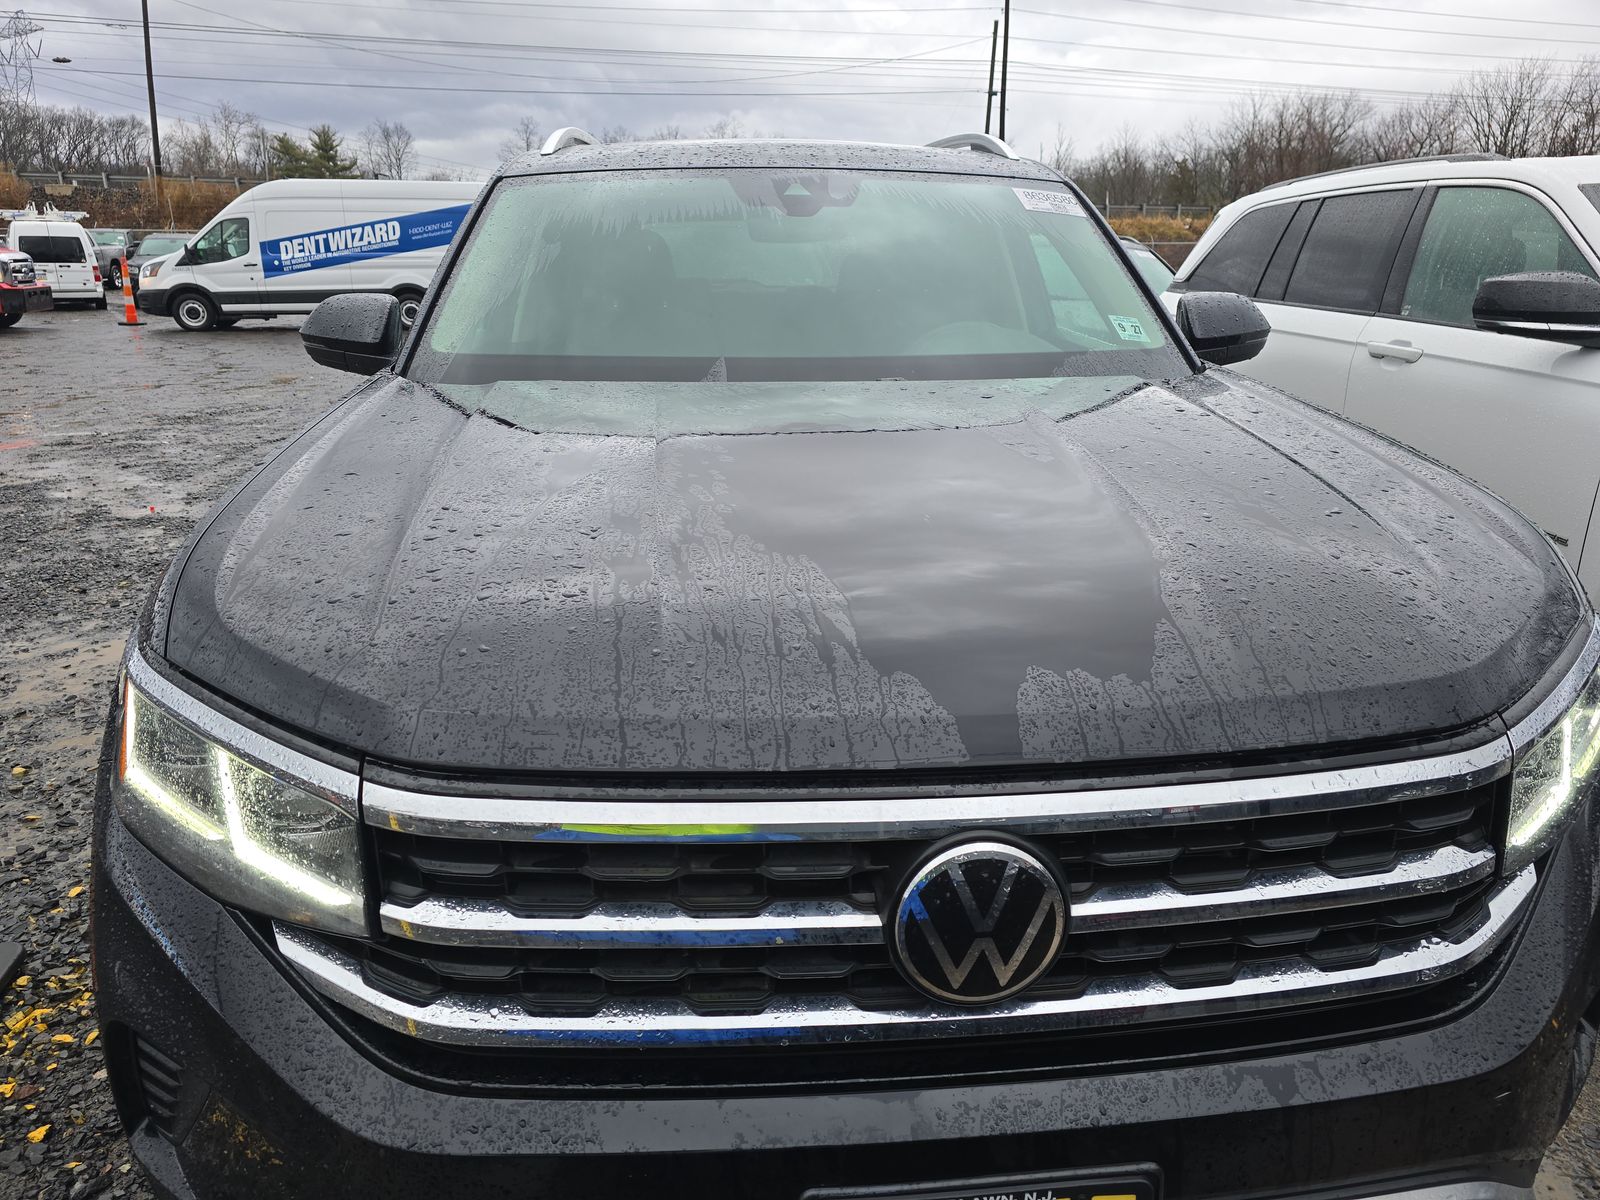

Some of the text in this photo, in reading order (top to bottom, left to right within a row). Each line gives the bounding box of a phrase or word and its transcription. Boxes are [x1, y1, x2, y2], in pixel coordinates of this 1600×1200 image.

[280, 220, 401, 260] DENT WIZARD
[292, 256, 309, 265] WORLD
[309, 252, 327, 262] LEADER
[283, 261, 312, 272] KEY DIVISION
[1117, 322, 1143, 335] 9 27
